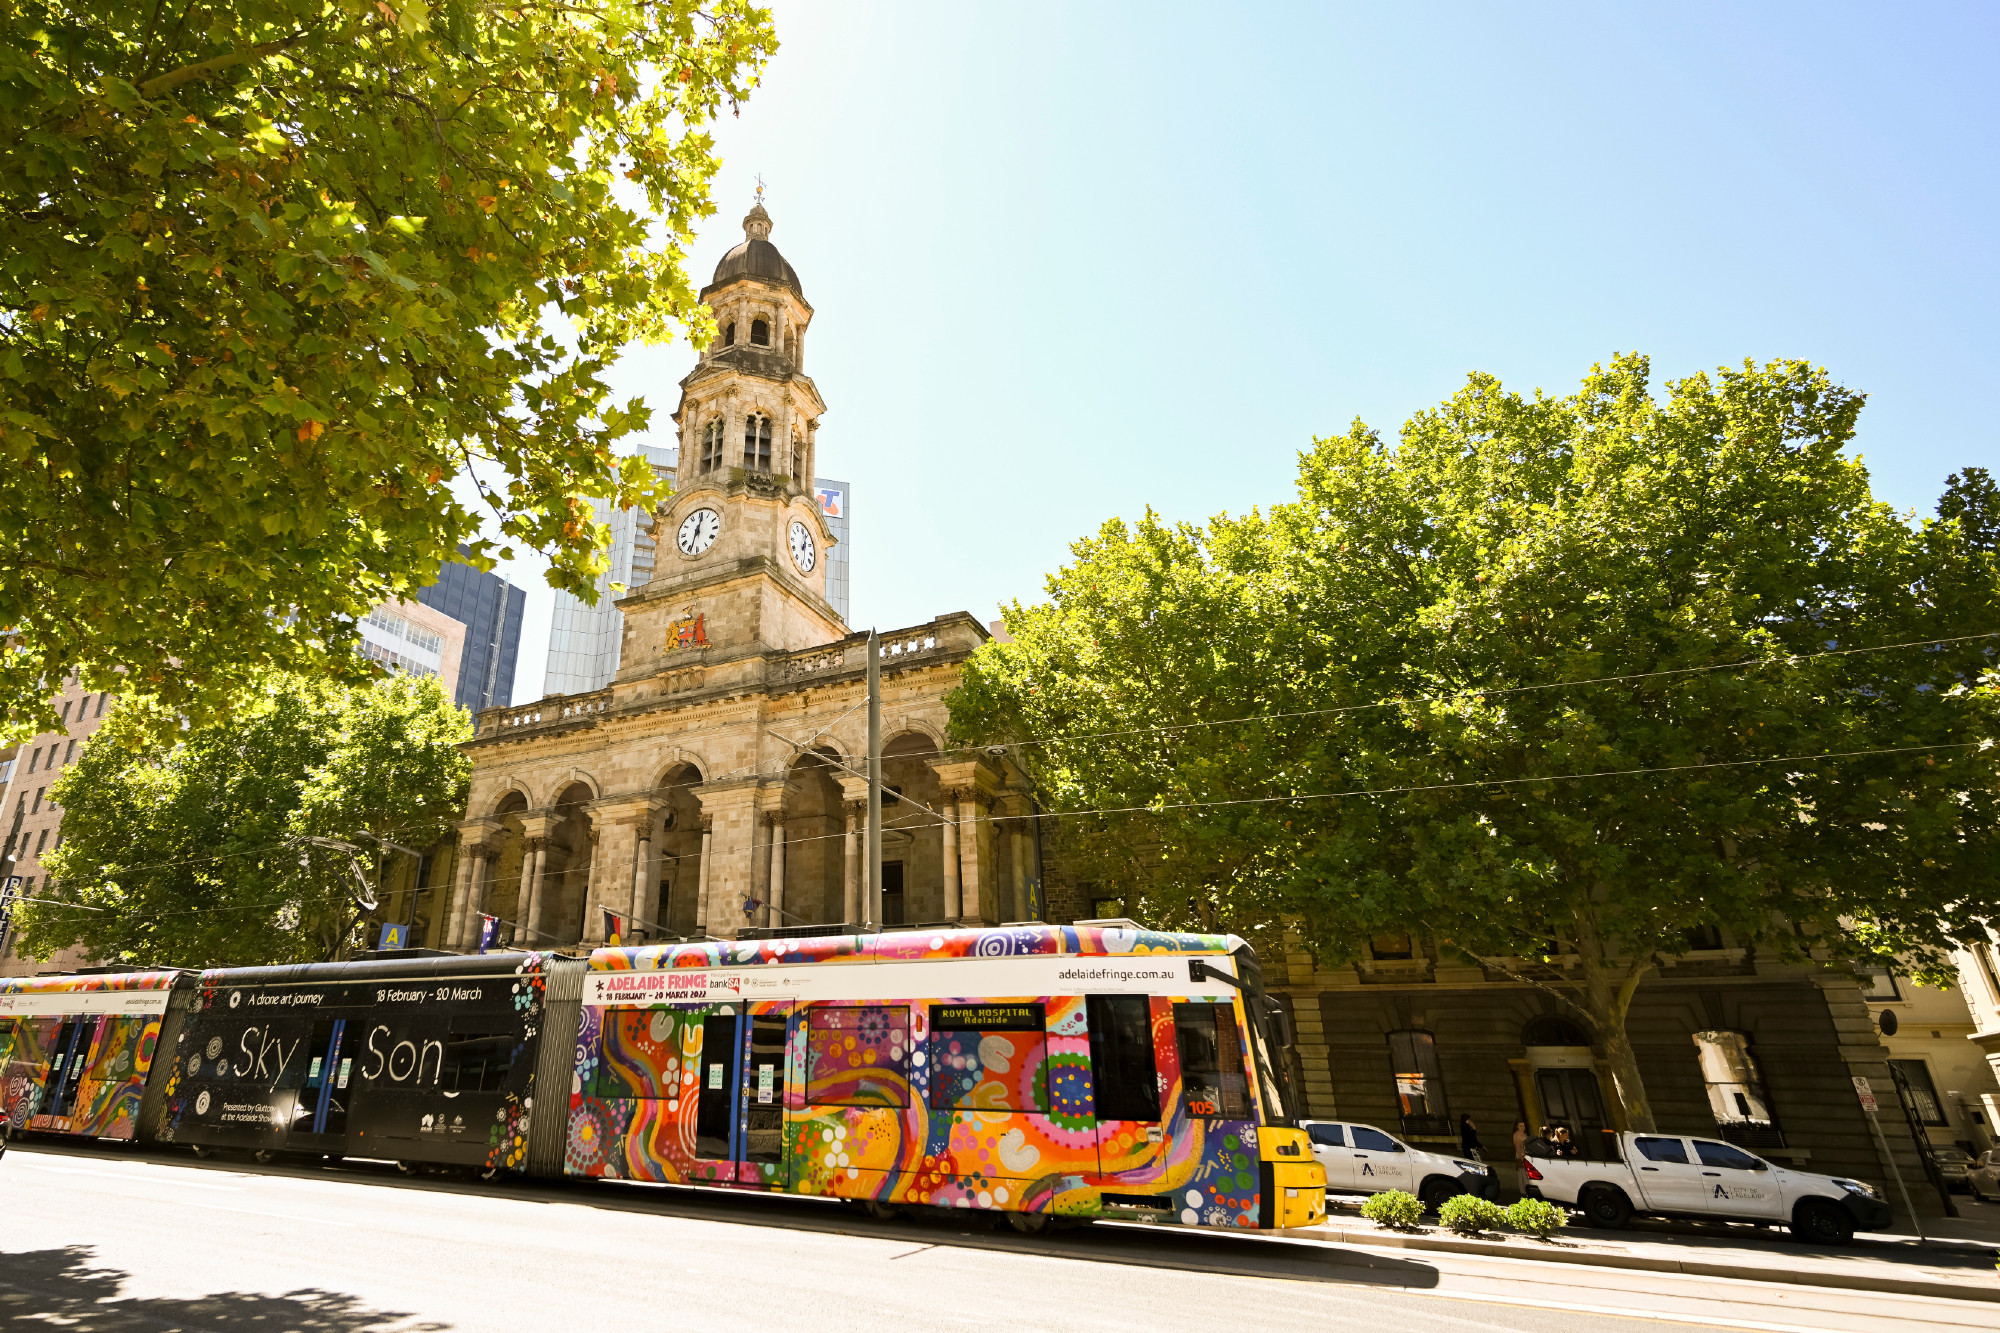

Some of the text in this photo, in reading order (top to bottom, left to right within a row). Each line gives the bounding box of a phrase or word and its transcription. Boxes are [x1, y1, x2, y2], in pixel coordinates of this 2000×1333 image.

[821, 489, 840, 508] T
[1030, 883, 1038, 906] A
[385, 927, 398, 945] A
[1059, 969, 1174, 981] adelaidefringe.com.au
[606, 974, 707, 991] ADELAIDE FRINGE
[248, 992, 324, 1007] A drone art journey
[376, 989, 386, 1002] 18
[387, 989, 427, 1003] February
[436, 987, 450, 1001] 20
[451, 986, 482, 1001] March
[614, 992, 647, 1000] FEBRUARY
[655, 992, 664, 1000] 20
[665, 991, 688, 999] MARCH
[690, 990, 707, 999] 2022
[942, 1008, 1031, 1018] ROYAL HOSPITAL
[964, 1016, 1008, 1024] Adelaide
[234, 1024, 459, 1098] Sky Son
[223, 1102, 247, 1111] Presented
[247, 1104, 255, 1113] by
[1188, 1101, 1215, 1115] 105
[227, 1113, 236, 1121] the
[236, 1113, 257, 1122] Adelaide
